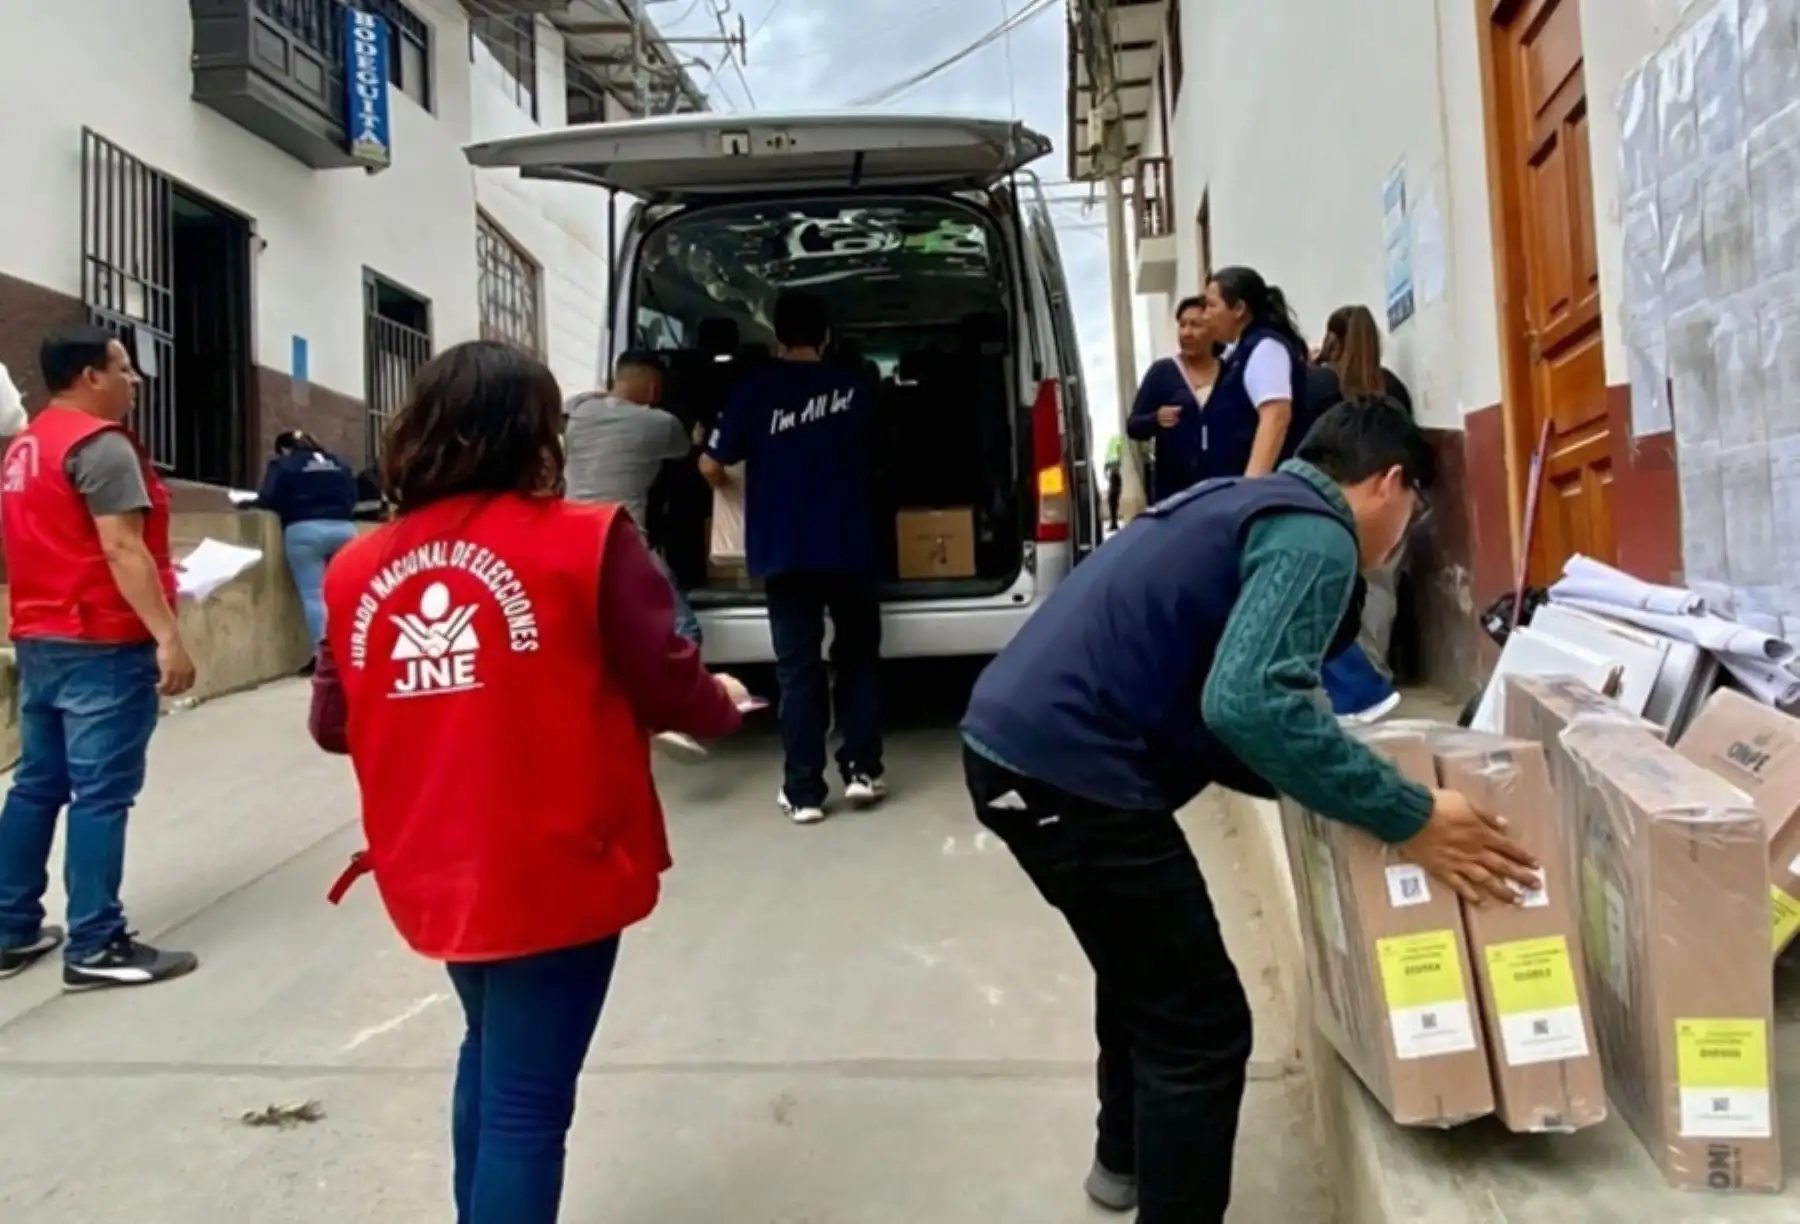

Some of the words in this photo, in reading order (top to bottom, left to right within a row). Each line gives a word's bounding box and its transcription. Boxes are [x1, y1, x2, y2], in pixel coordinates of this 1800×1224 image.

[353, 11, 387, 149] BODEGUITA
[801, 394, 828, 424] All
[351, 592, 379, 670] JURADO
[369, 540, 449, 600] NACIONAL
[450, 539, 477, 570] DE
[468, 546, 540, 653] ELECCIONES
[393, 652, 476, 692] JNE
[1727, 740, 1771, 773] ONPE
